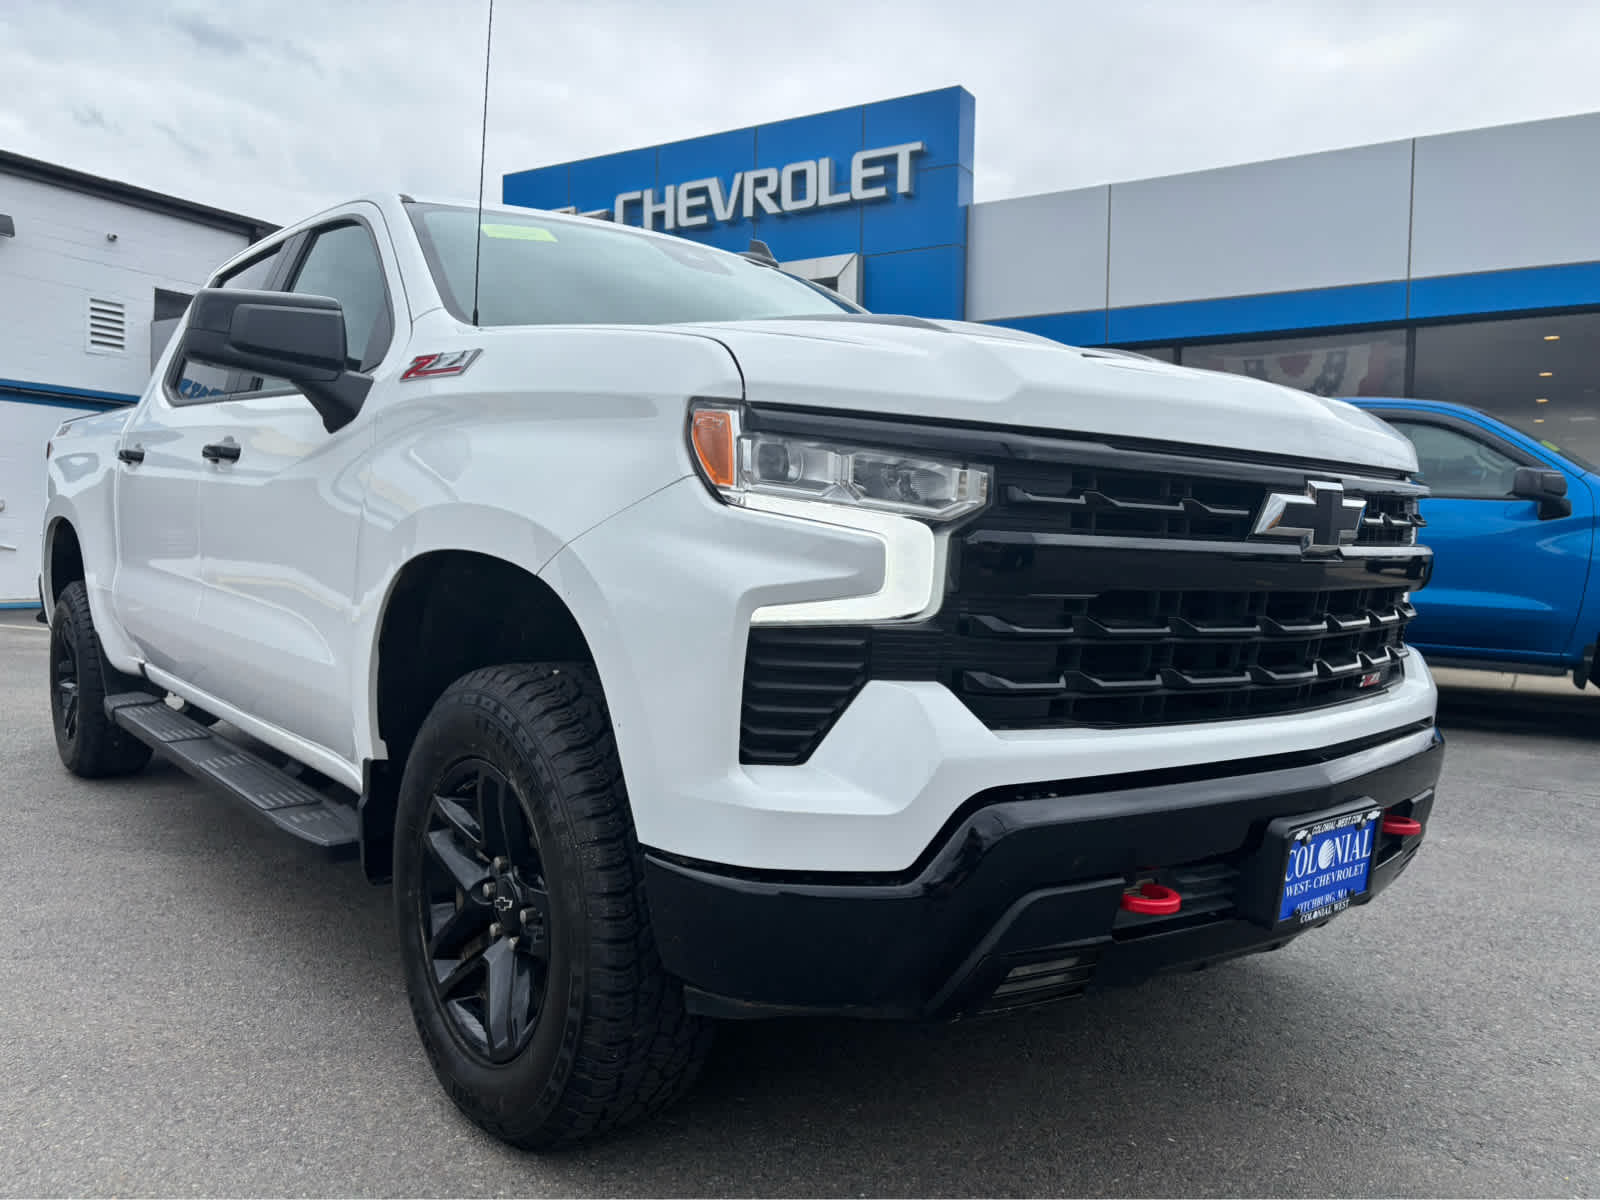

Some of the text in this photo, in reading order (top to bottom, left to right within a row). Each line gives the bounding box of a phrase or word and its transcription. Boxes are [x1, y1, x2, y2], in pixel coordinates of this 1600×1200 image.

[614, 141, 926, 231] CHEVROLET
[1284, 829, 1372, 882] COLONIAL
[1313, 862, 1366, 889] CHEVROLET
